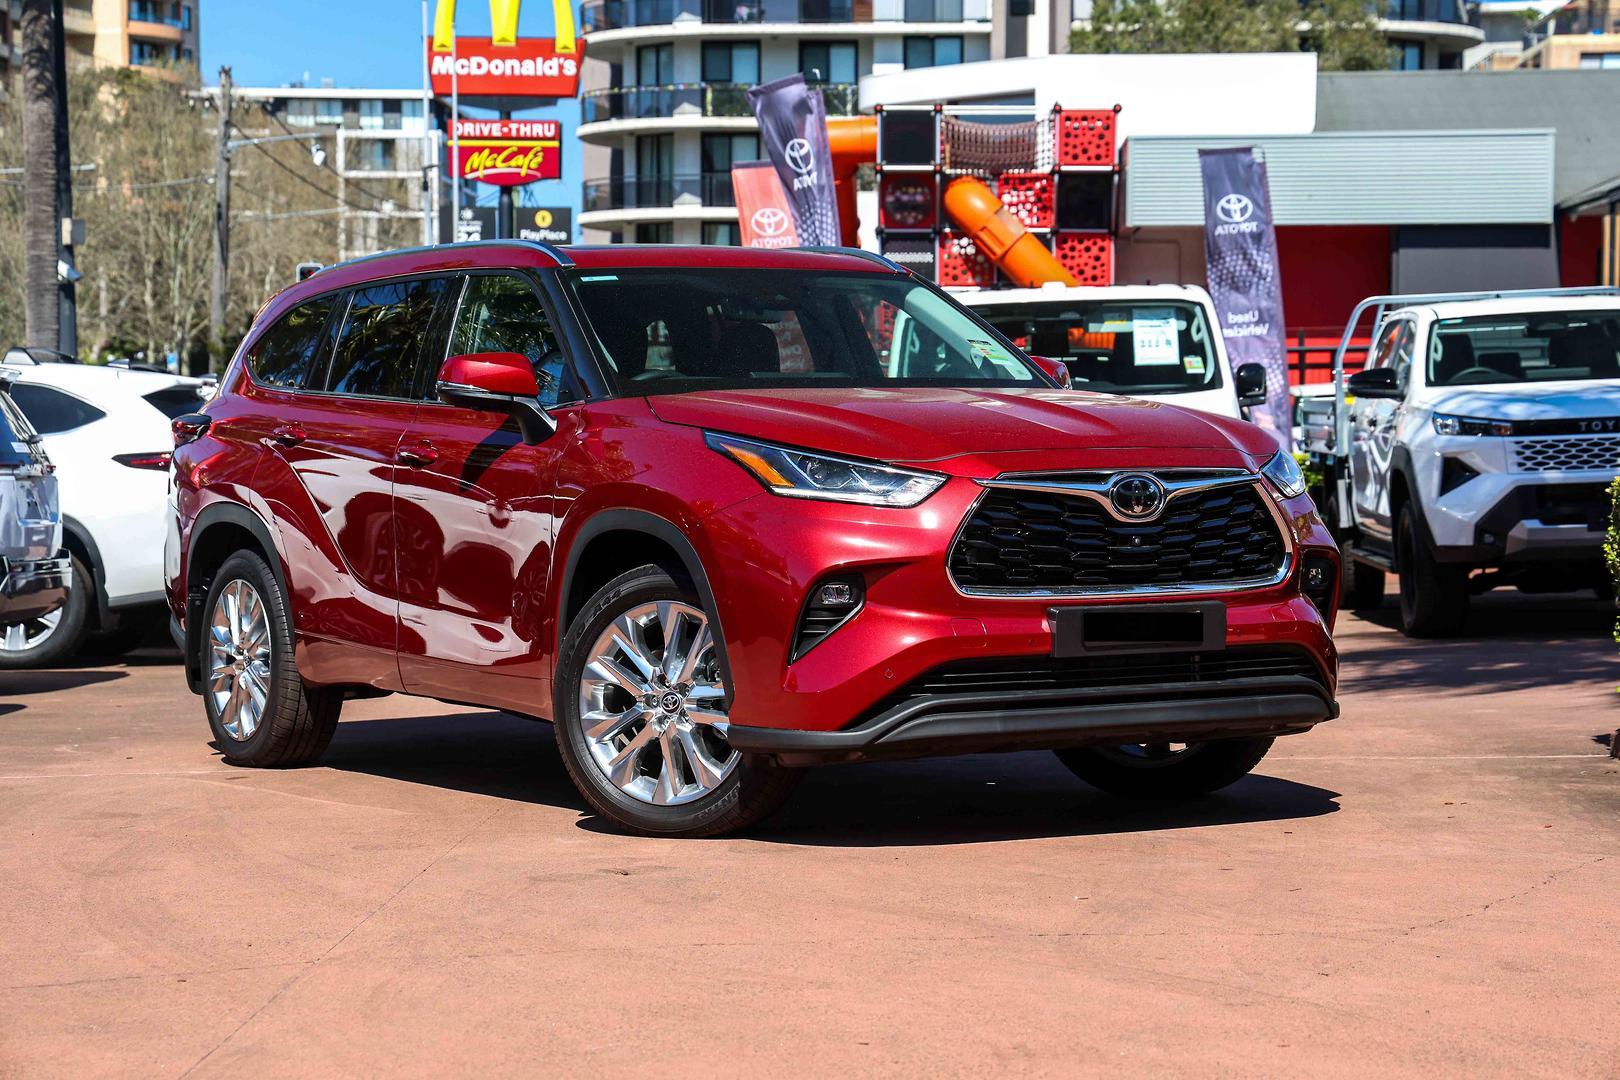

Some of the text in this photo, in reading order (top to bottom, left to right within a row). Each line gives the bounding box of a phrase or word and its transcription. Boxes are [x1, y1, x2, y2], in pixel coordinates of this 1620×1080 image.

[431, 55, 577, 76] McDonald's
[464, 146, 544, 178] McCafé
[1579, 420, 1620, 432] TOY
